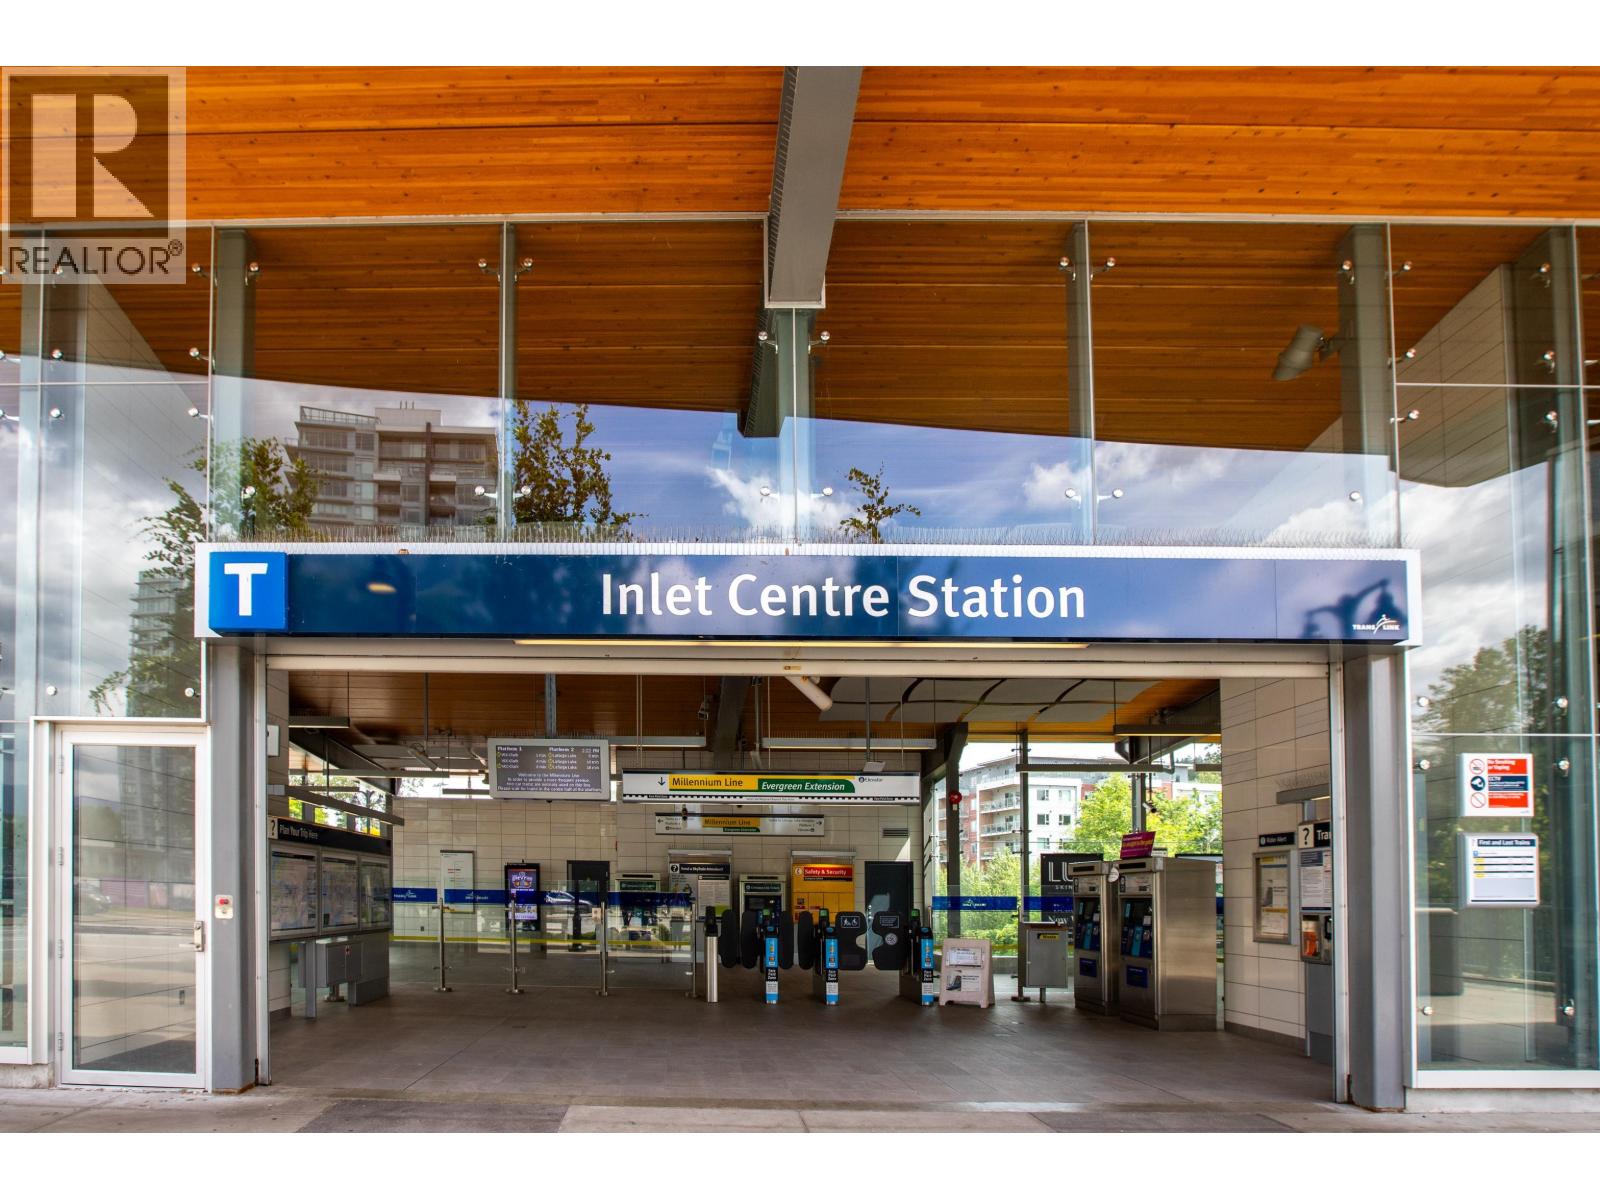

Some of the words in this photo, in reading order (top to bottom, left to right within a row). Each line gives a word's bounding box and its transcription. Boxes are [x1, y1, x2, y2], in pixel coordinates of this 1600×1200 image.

[224, 563, 268, 616] T
[602, 572, 713, 616] Inlet
[728, 573, 890, 617] Centre
[908, 574, 1085, 618] Station
[672, 777, 722, 787] Millennium
[724, 778, 743, 787] Line
[761, 782, 803, 792] Evergreen
[804, 782, 845, 791] Extension
[290, 826, 300, 837] Your
[300, 828, 309, 838] Trip
